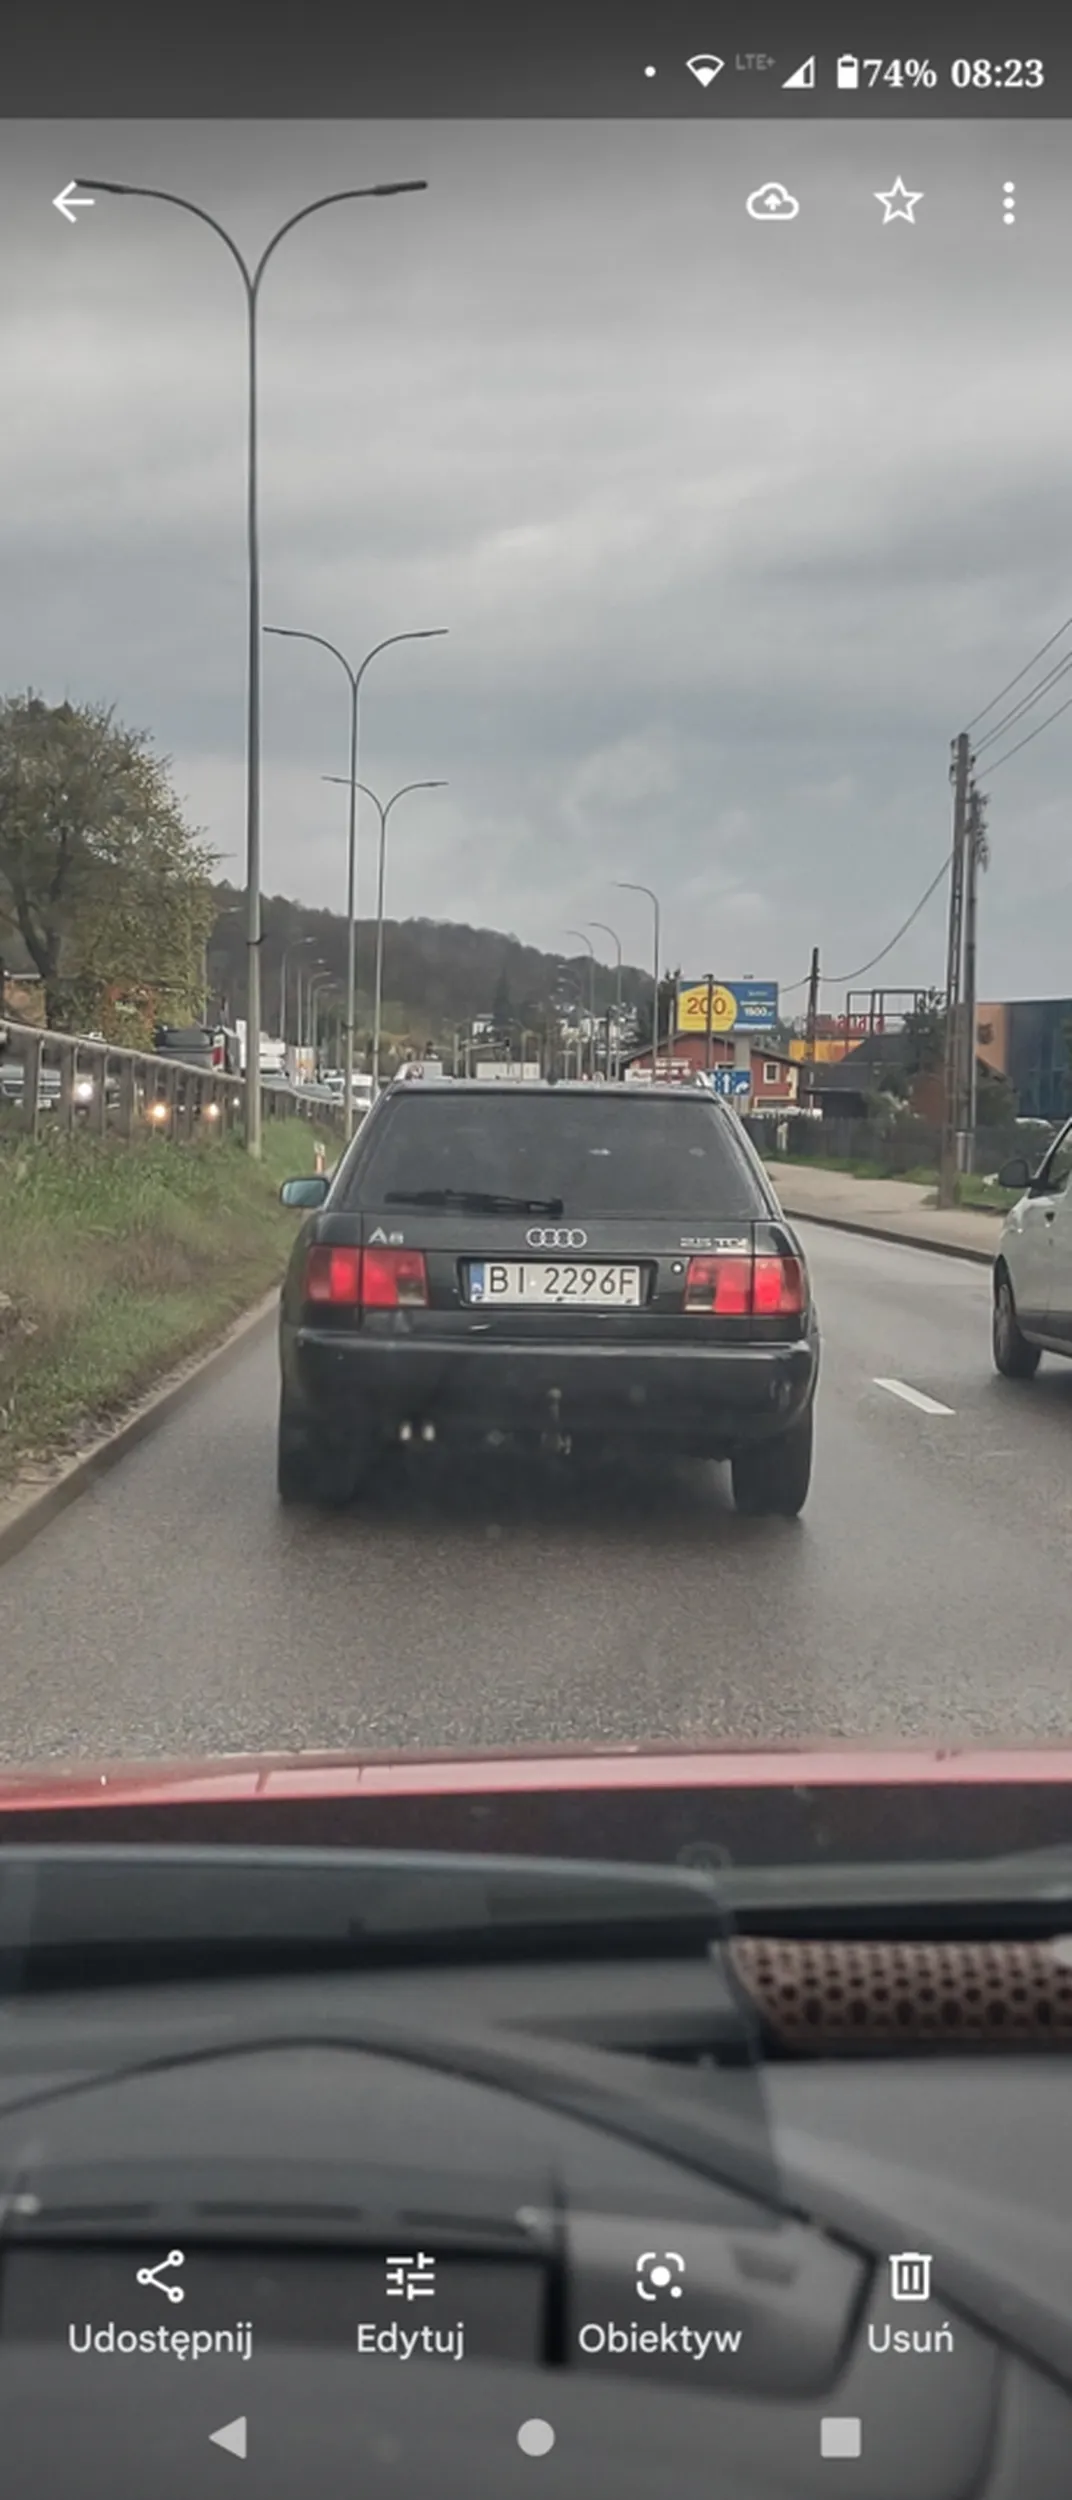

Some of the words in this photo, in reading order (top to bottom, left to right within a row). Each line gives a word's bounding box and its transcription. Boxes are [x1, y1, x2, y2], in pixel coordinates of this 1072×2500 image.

[686, 996, 727, 1015] 200
[489, 1266, 524, 1294] BI
[543, 1267, 636, 1296] 2296F
